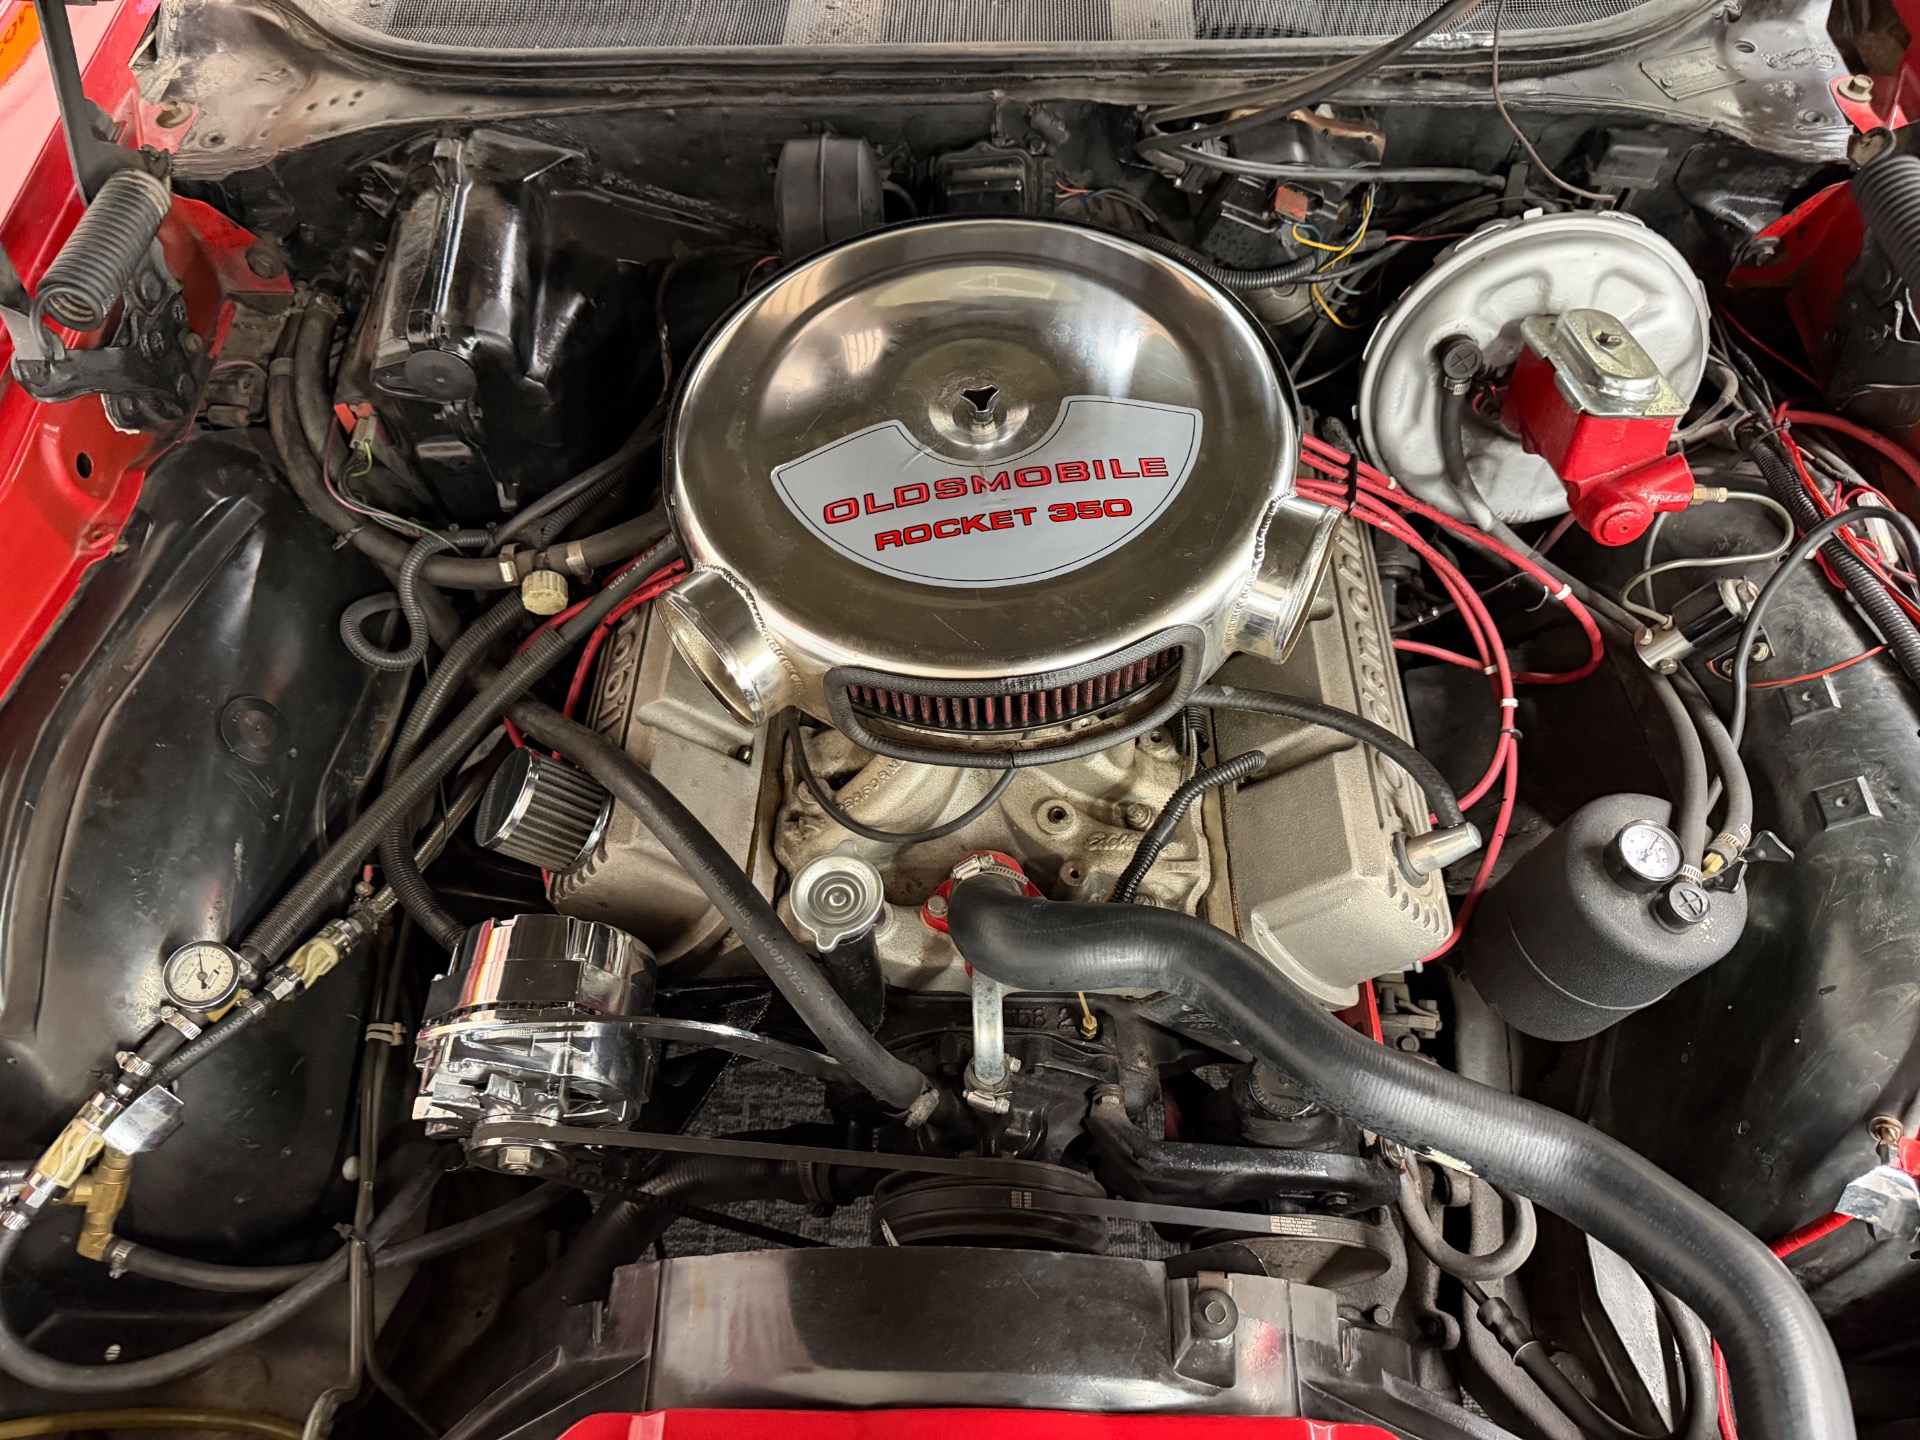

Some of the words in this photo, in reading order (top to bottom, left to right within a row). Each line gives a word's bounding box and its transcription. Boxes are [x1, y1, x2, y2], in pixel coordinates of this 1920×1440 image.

[823, 456, 1169, 523] OLDSMOBILE
[874, 509, 1034, 551] ROCKET
[1050, 498, 1133, 523] 350
[703, 866, 731, 895] MADE
[734, 902, 756, 925] USA
[758, 933, 808, 997] GOODYEAR
[180, 1044, 204, 1062] MADE
